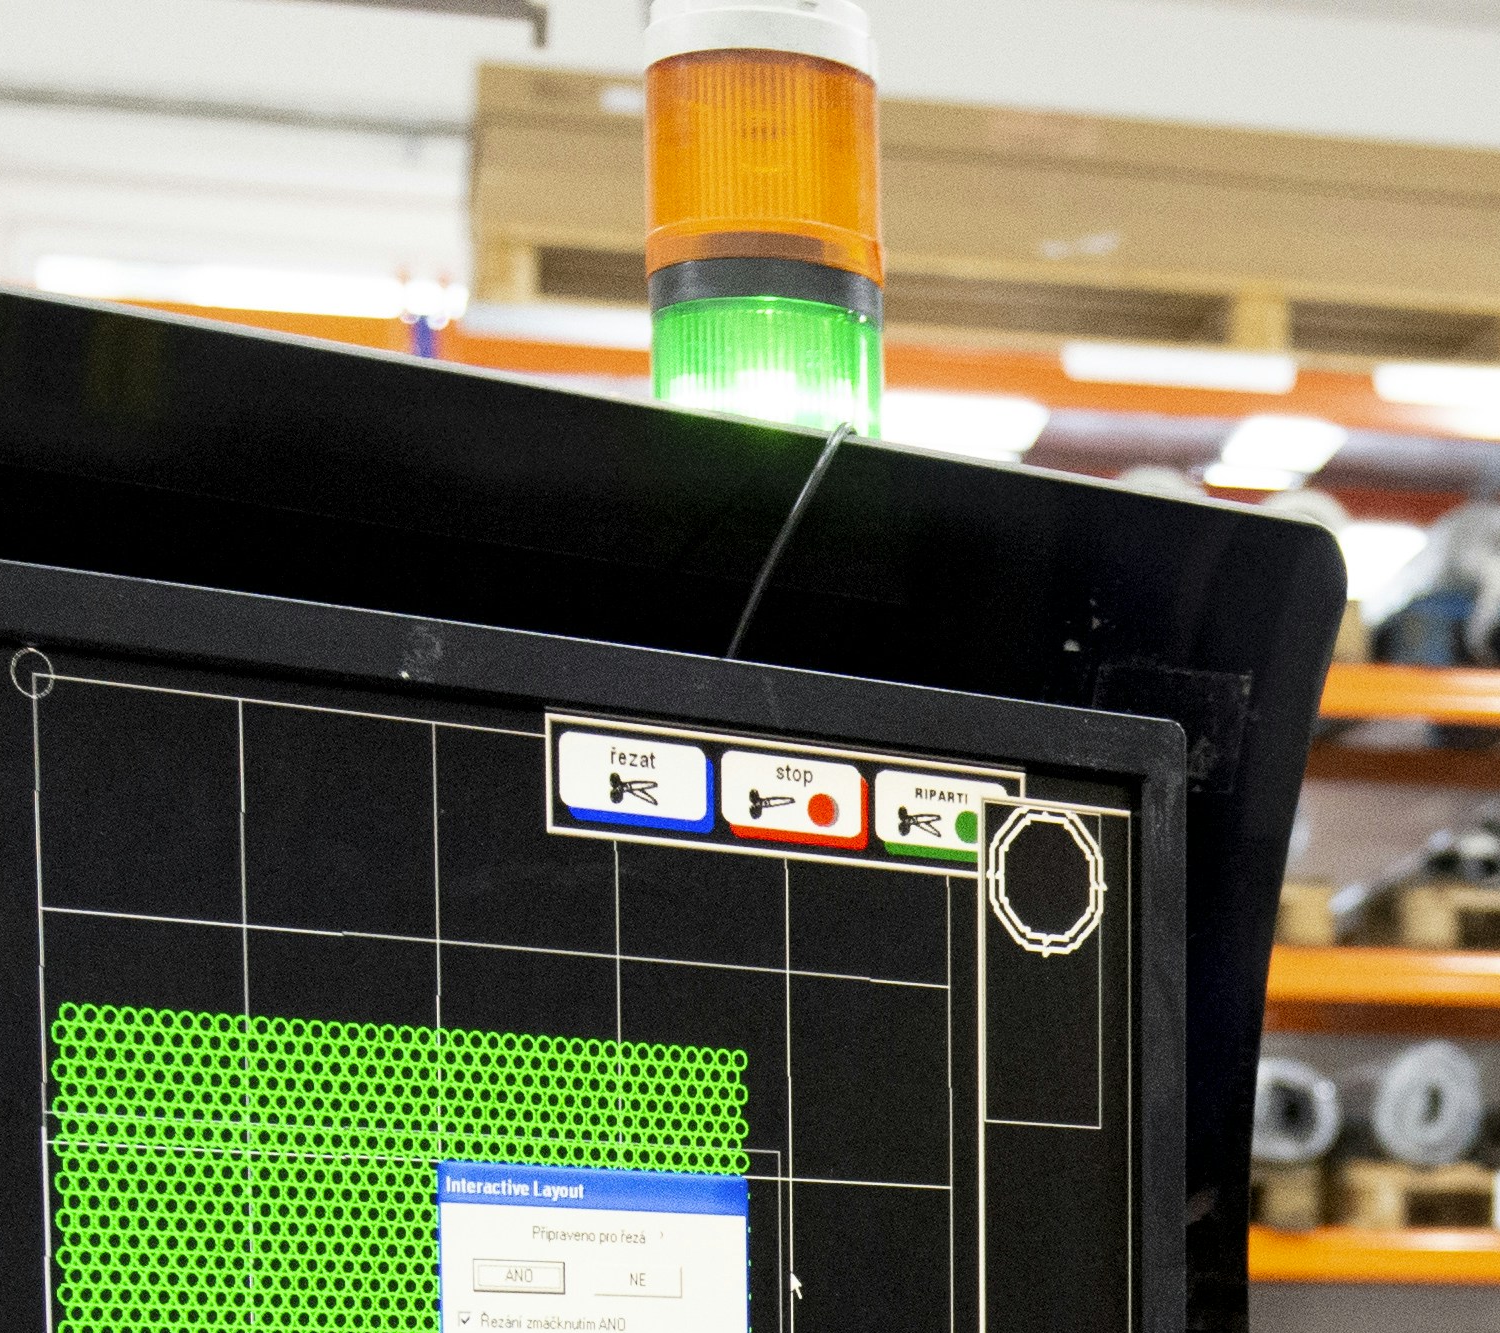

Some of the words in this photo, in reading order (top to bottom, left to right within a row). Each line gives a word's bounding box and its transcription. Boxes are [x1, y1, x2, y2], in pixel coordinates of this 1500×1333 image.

[610, 747, 657, 770] řezat
[776, 765, 814, 784] stop
[915, 786, 969, 804] RIPARTI
[446, 1176, 530, 1197] Interactive
[533, 1180, 584, 1201] Layout
[532, 1226, 596, 1243] Připraveno
[599, 1231, 618, 1244] pro
[630, 1272, 646, 1287] NE
